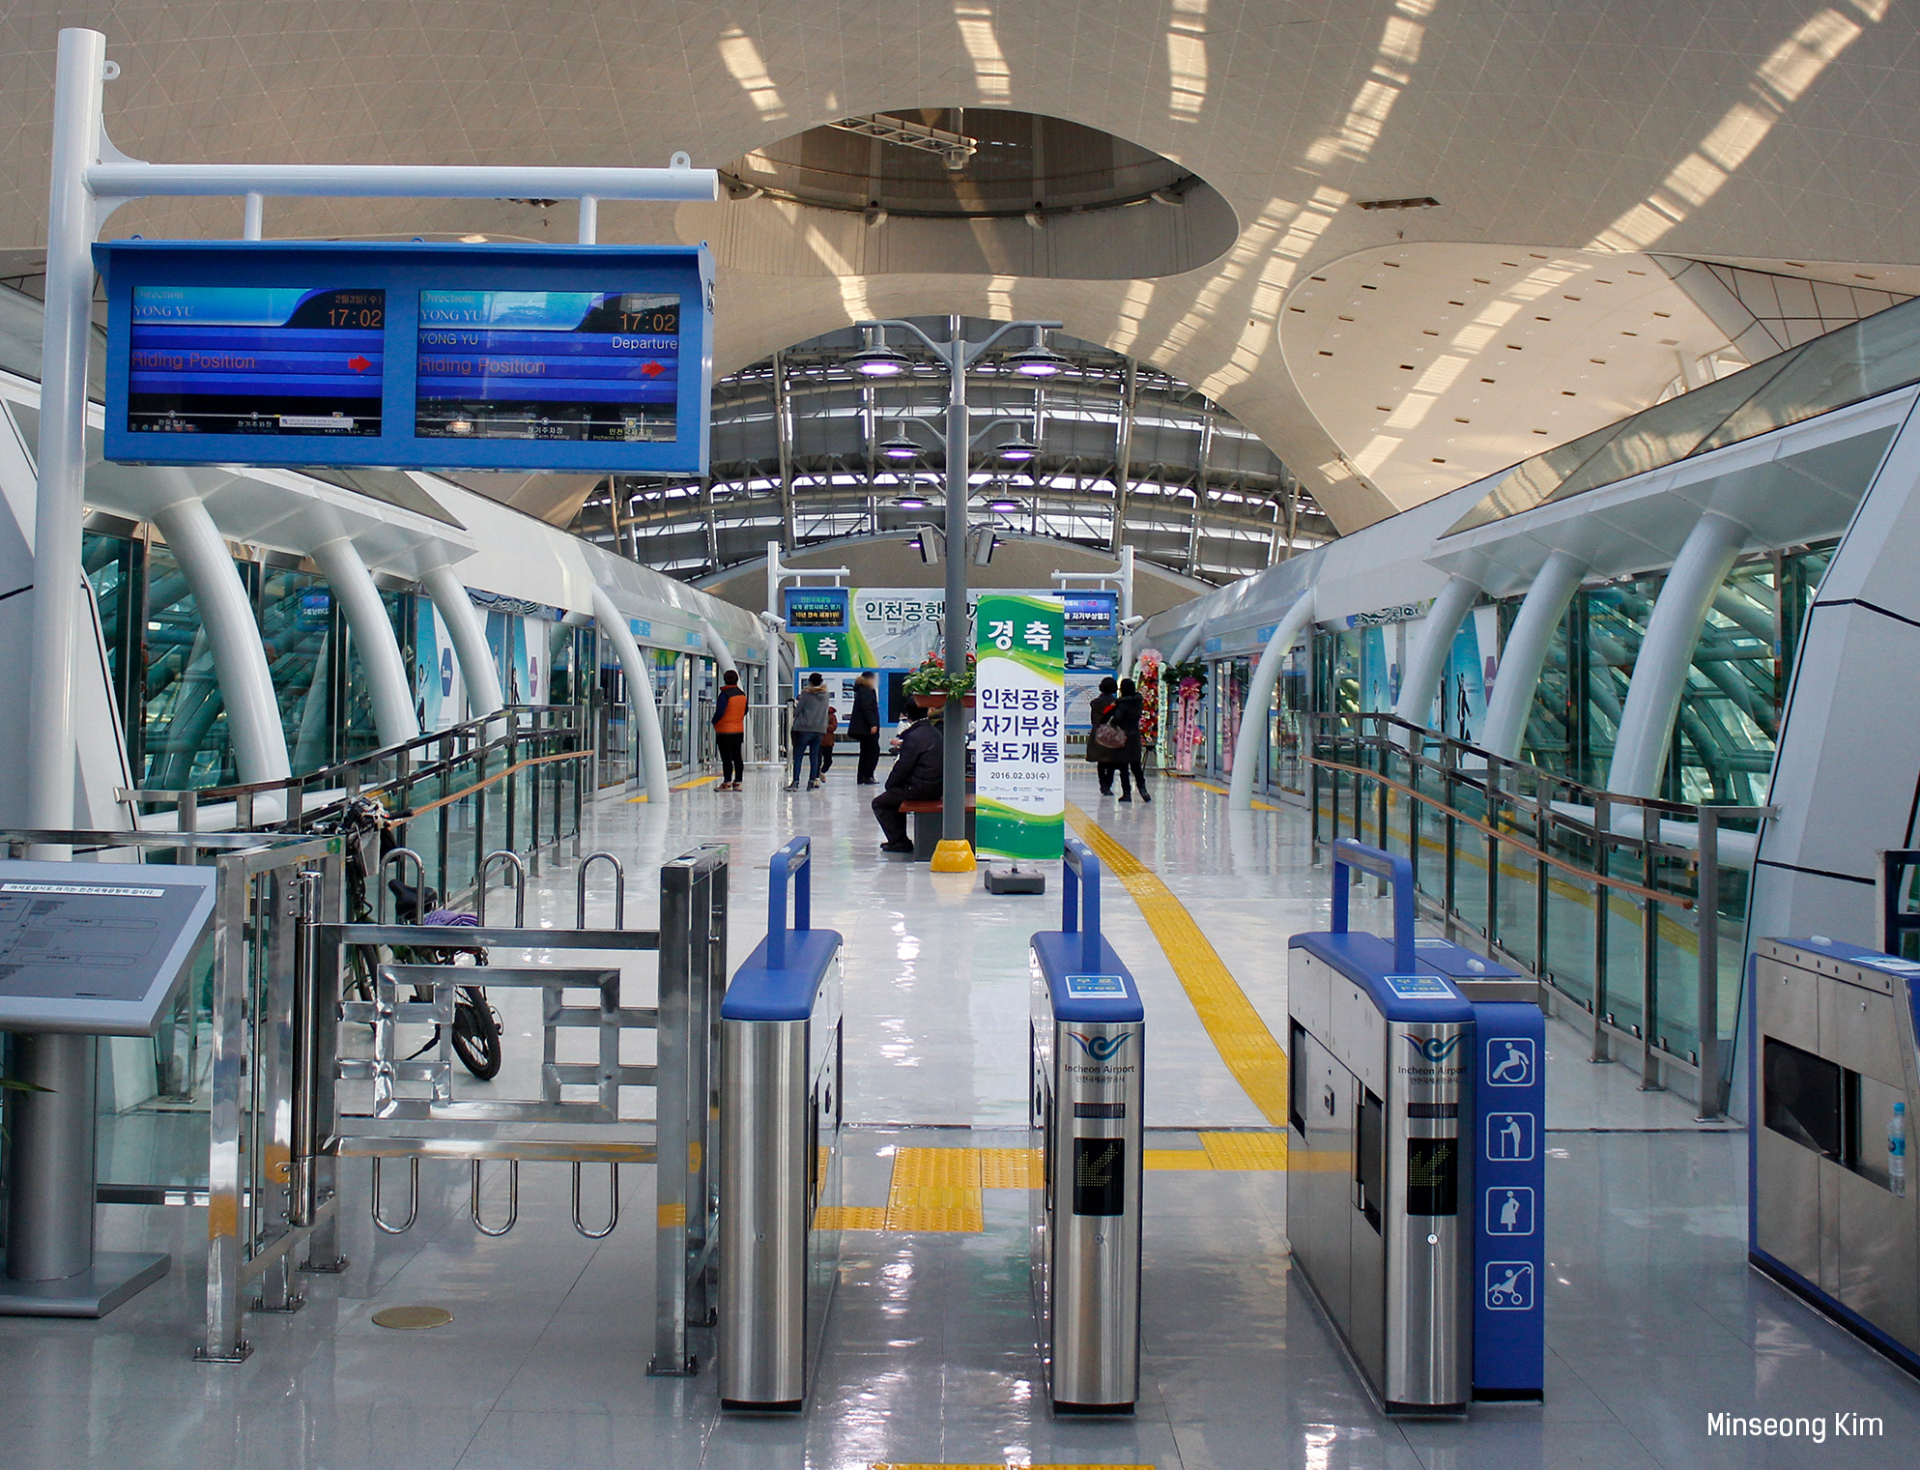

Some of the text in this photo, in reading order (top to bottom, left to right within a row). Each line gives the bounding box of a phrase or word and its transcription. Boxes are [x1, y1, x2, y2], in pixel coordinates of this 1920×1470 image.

[133, 306, 194, 317] YONG YU
[328, 308, 382, 327] 17:02
[421, 309, 483, 321] YONG YU
[620, 313, 676, 332] 17:02
[420, 333, 479, 346] YONG YU
[612, 336, 678, 350] Departure
[132, 351, 256, 370] Riding Position
[419, 356, 547, 375] Riding Position
[527, 426, 564, 435] 장기주차장
[864, 601, 941, 622] 인천공항
[1072, 612, 1110, 620] 자기부상열차
[817, 637, 839, 660] 축
[981, 688, 1060, 711] 인천공항
[981, 715, 1060, 737] 자기부상
[981, 741, 1060, 764] 철도개통
[990, 771, 1050, 780] 2016.02.03(수)
[1064, 1063, 1135, 1075] Incheon Airport
[1398, 1066, 1468, 1076] Incheon Airport
